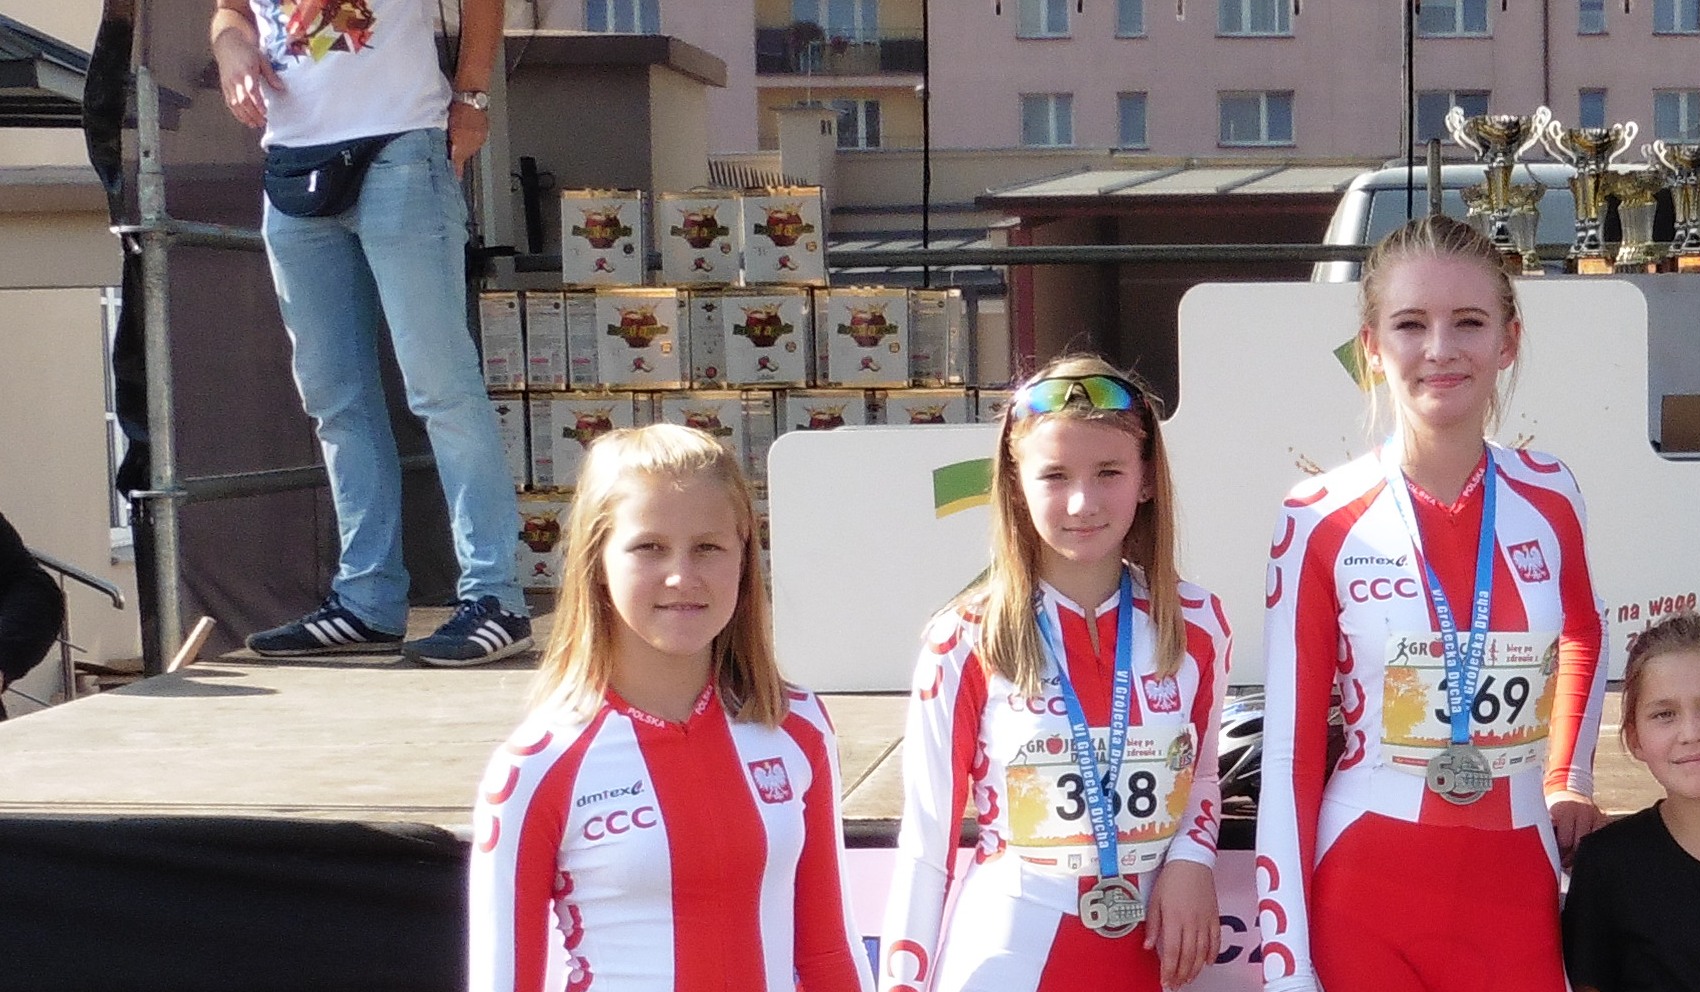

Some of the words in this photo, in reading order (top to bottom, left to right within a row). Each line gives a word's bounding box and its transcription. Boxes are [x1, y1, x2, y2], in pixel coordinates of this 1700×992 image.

[1349, 578, 1419, 603] CCC
[1617, 603, 1640, 623] na
[627, 706, 666, 729] POLSKA
[583, 806, 658, 841] CCC
